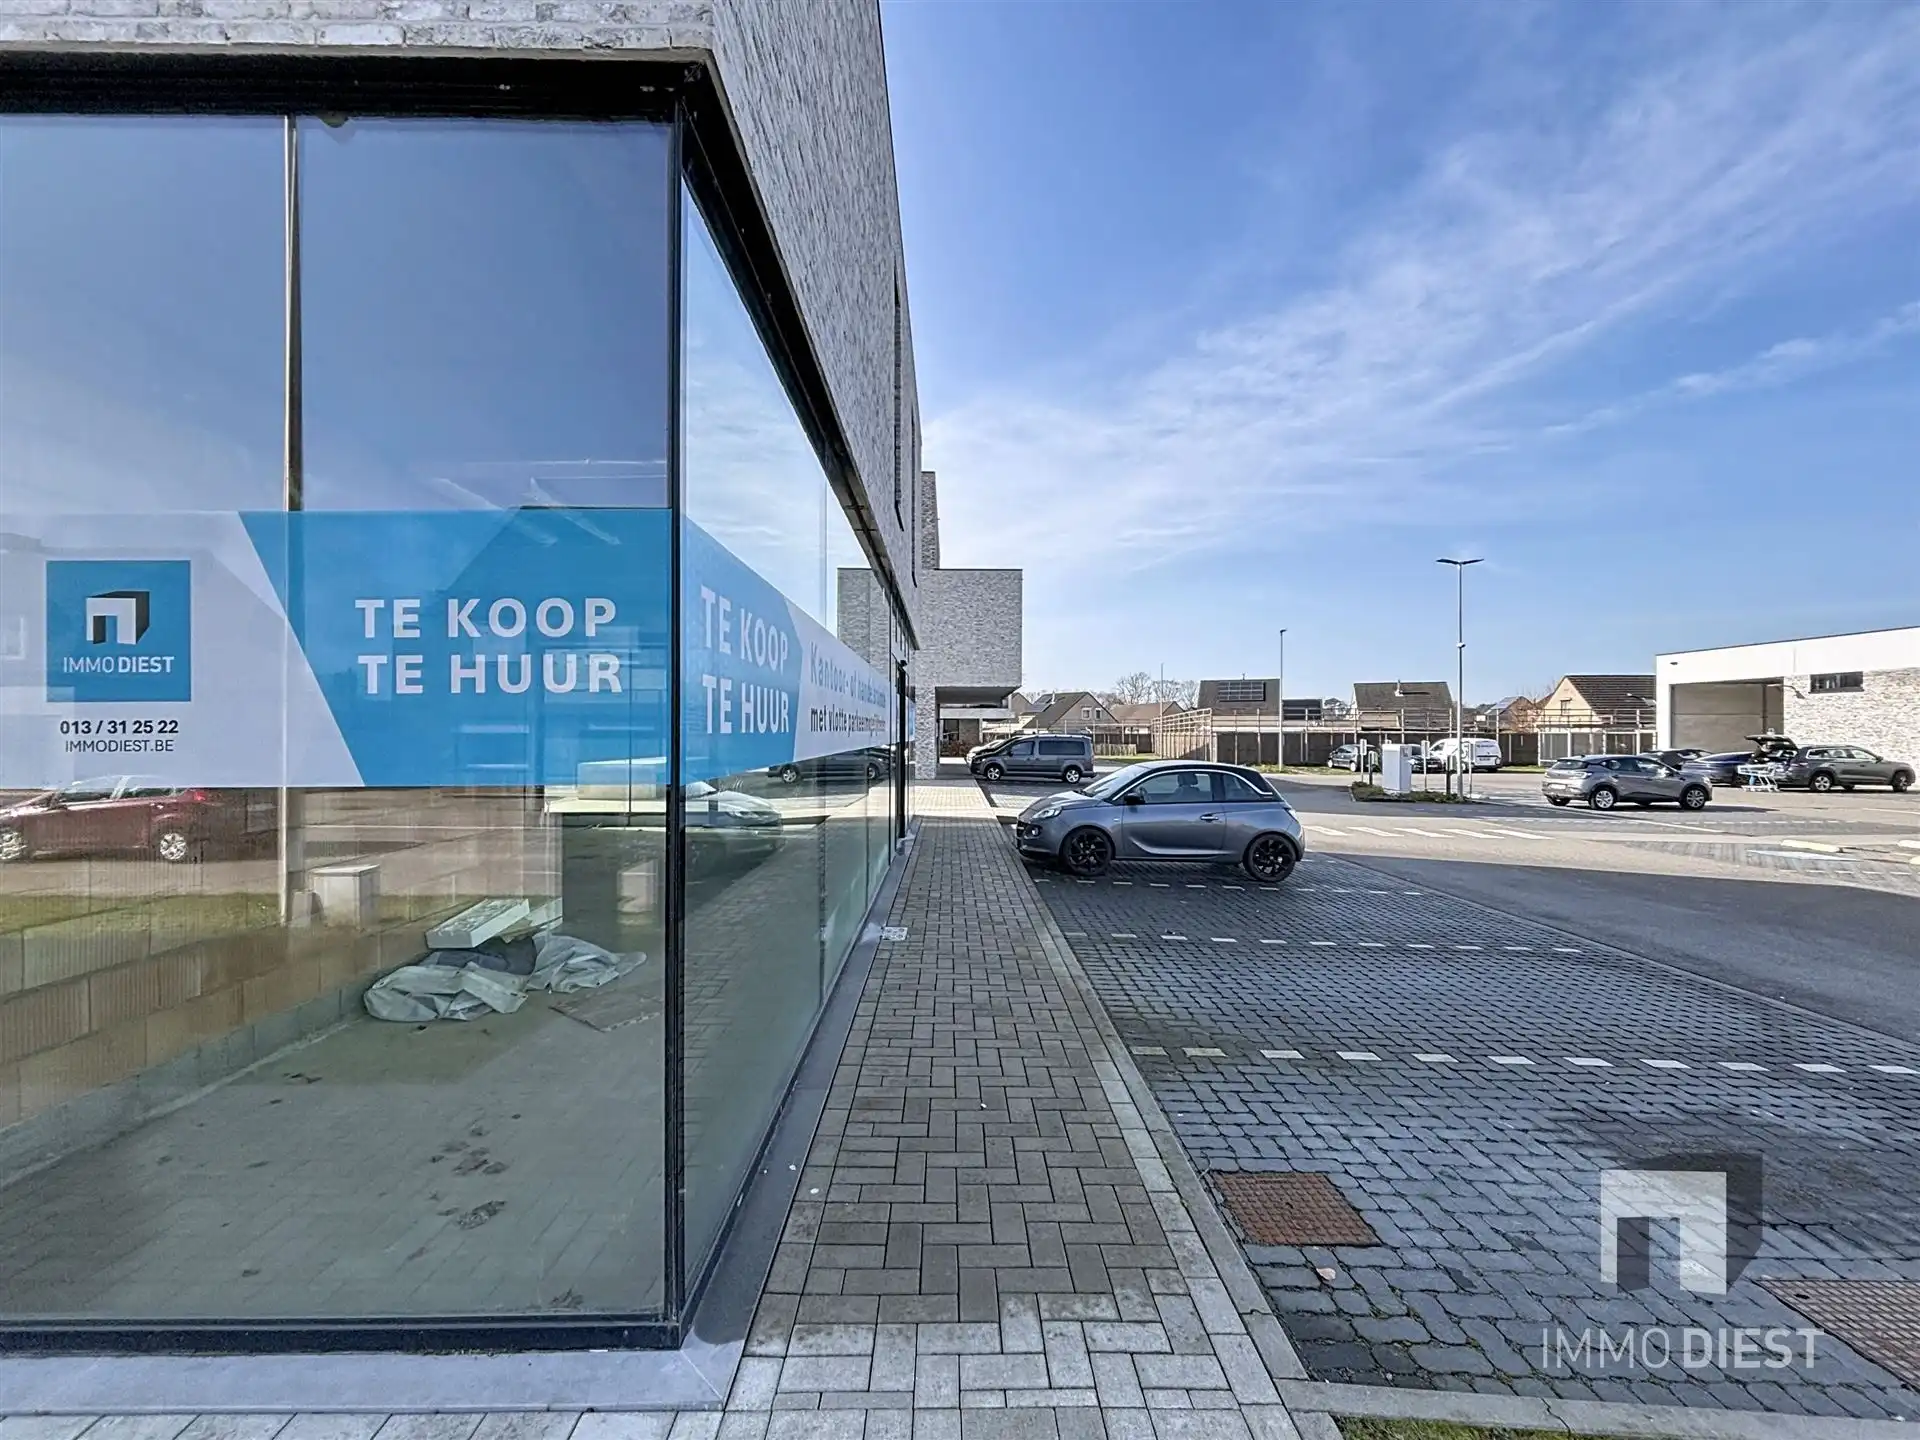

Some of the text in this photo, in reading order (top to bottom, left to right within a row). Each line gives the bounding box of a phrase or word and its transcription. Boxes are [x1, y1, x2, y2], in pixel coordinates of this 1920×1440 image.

[355, 597, 617, 638] TE KOOP
[700, 584, 788, 673] TE KOOP
[63, 656, 175, 673] IMMO DIEST
[357, 653, 623, 694] TE HUUR
[702, 673, 732, 735] TE
[741, 682, 790, 734] HUUR
[810, 704, 827, 733] met
[828, 703, 847, 733] vlotte
[60, 720, 179, 735] 013 / 31 25 22
[65, 740, 174, 753] IMMODIEST.BE
